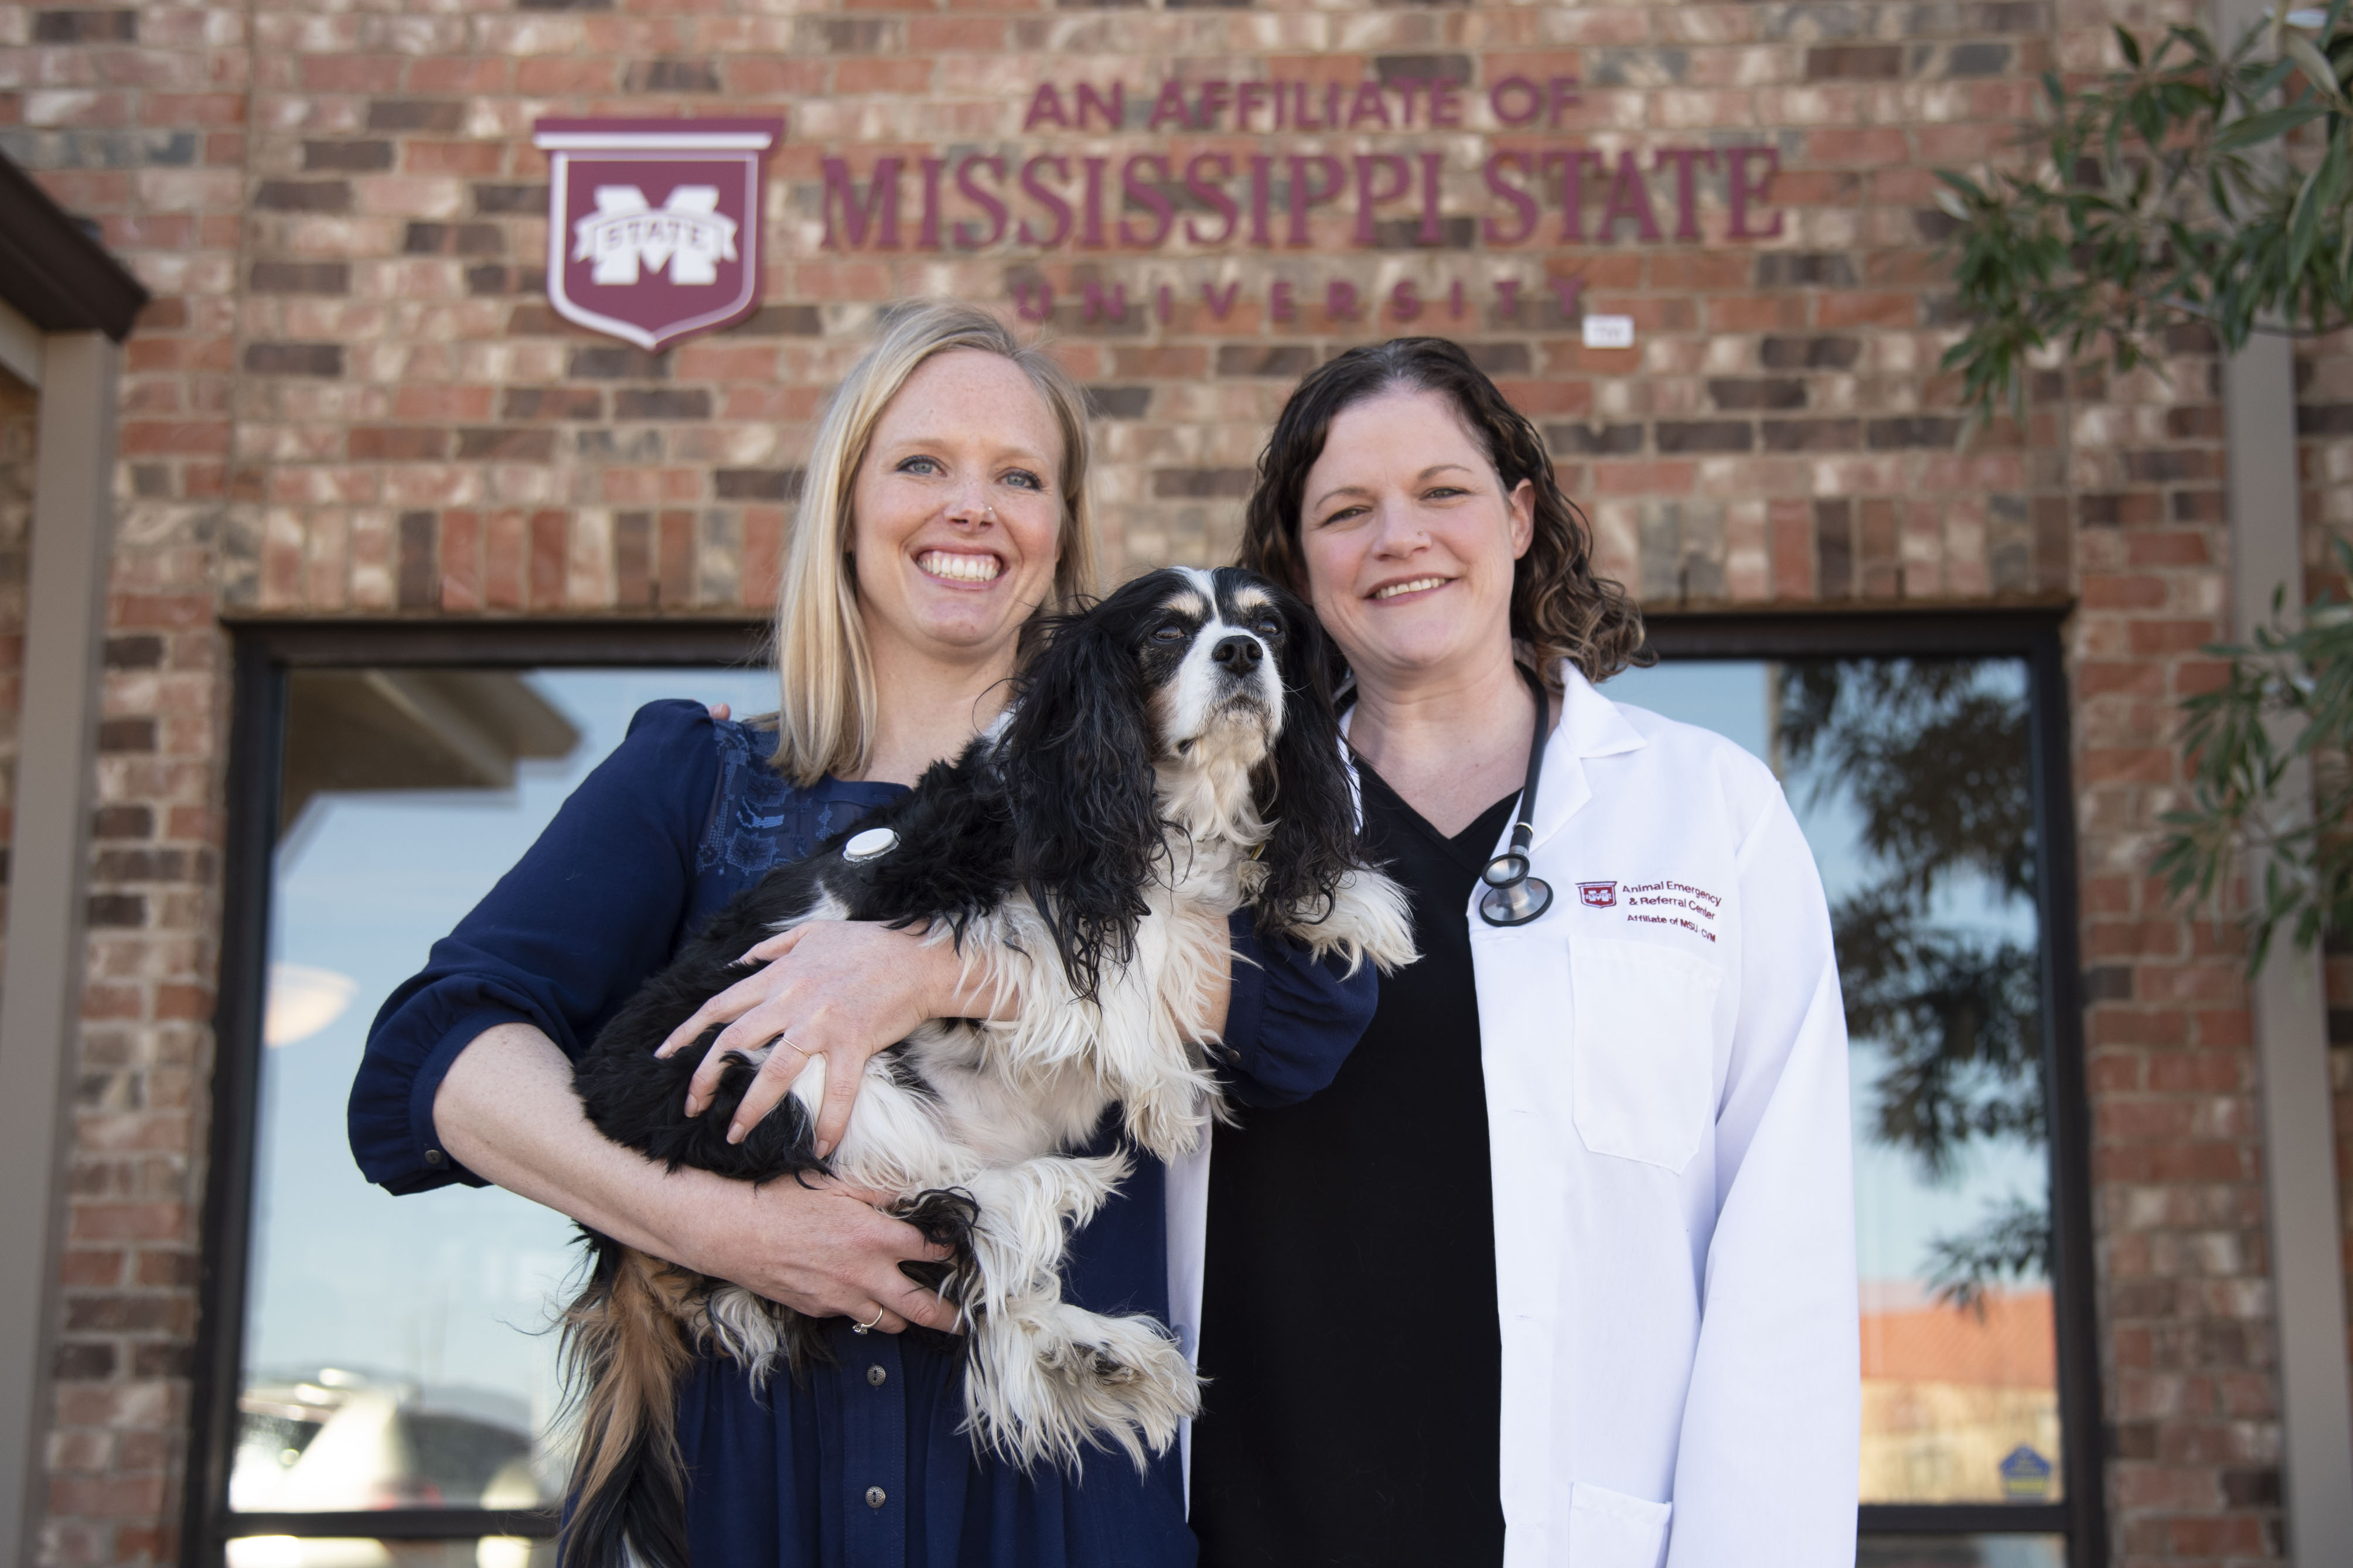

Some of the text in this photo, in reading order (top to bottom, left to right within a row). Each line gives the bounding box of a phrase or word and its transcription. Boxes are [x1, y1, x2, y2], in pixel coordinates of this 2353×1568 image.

[1023, 77, 1580, 131] AN AFFILIATE OF
[820, 148, 1782, 250] MISSISSIPPI STATE
[607, 220, 707, 252] STATE
[1015, 278, 1584, 324] UNIVERSITY
[1622, 881, 1721, 906] Animal Emergency
[1629, 896, 1715, 920] & Referral Center
[1627, 914, 1667, 923] Affiliate
[1680, 919, 1698, 932] MSU
[1701, 929, 1716, 942] CVM
